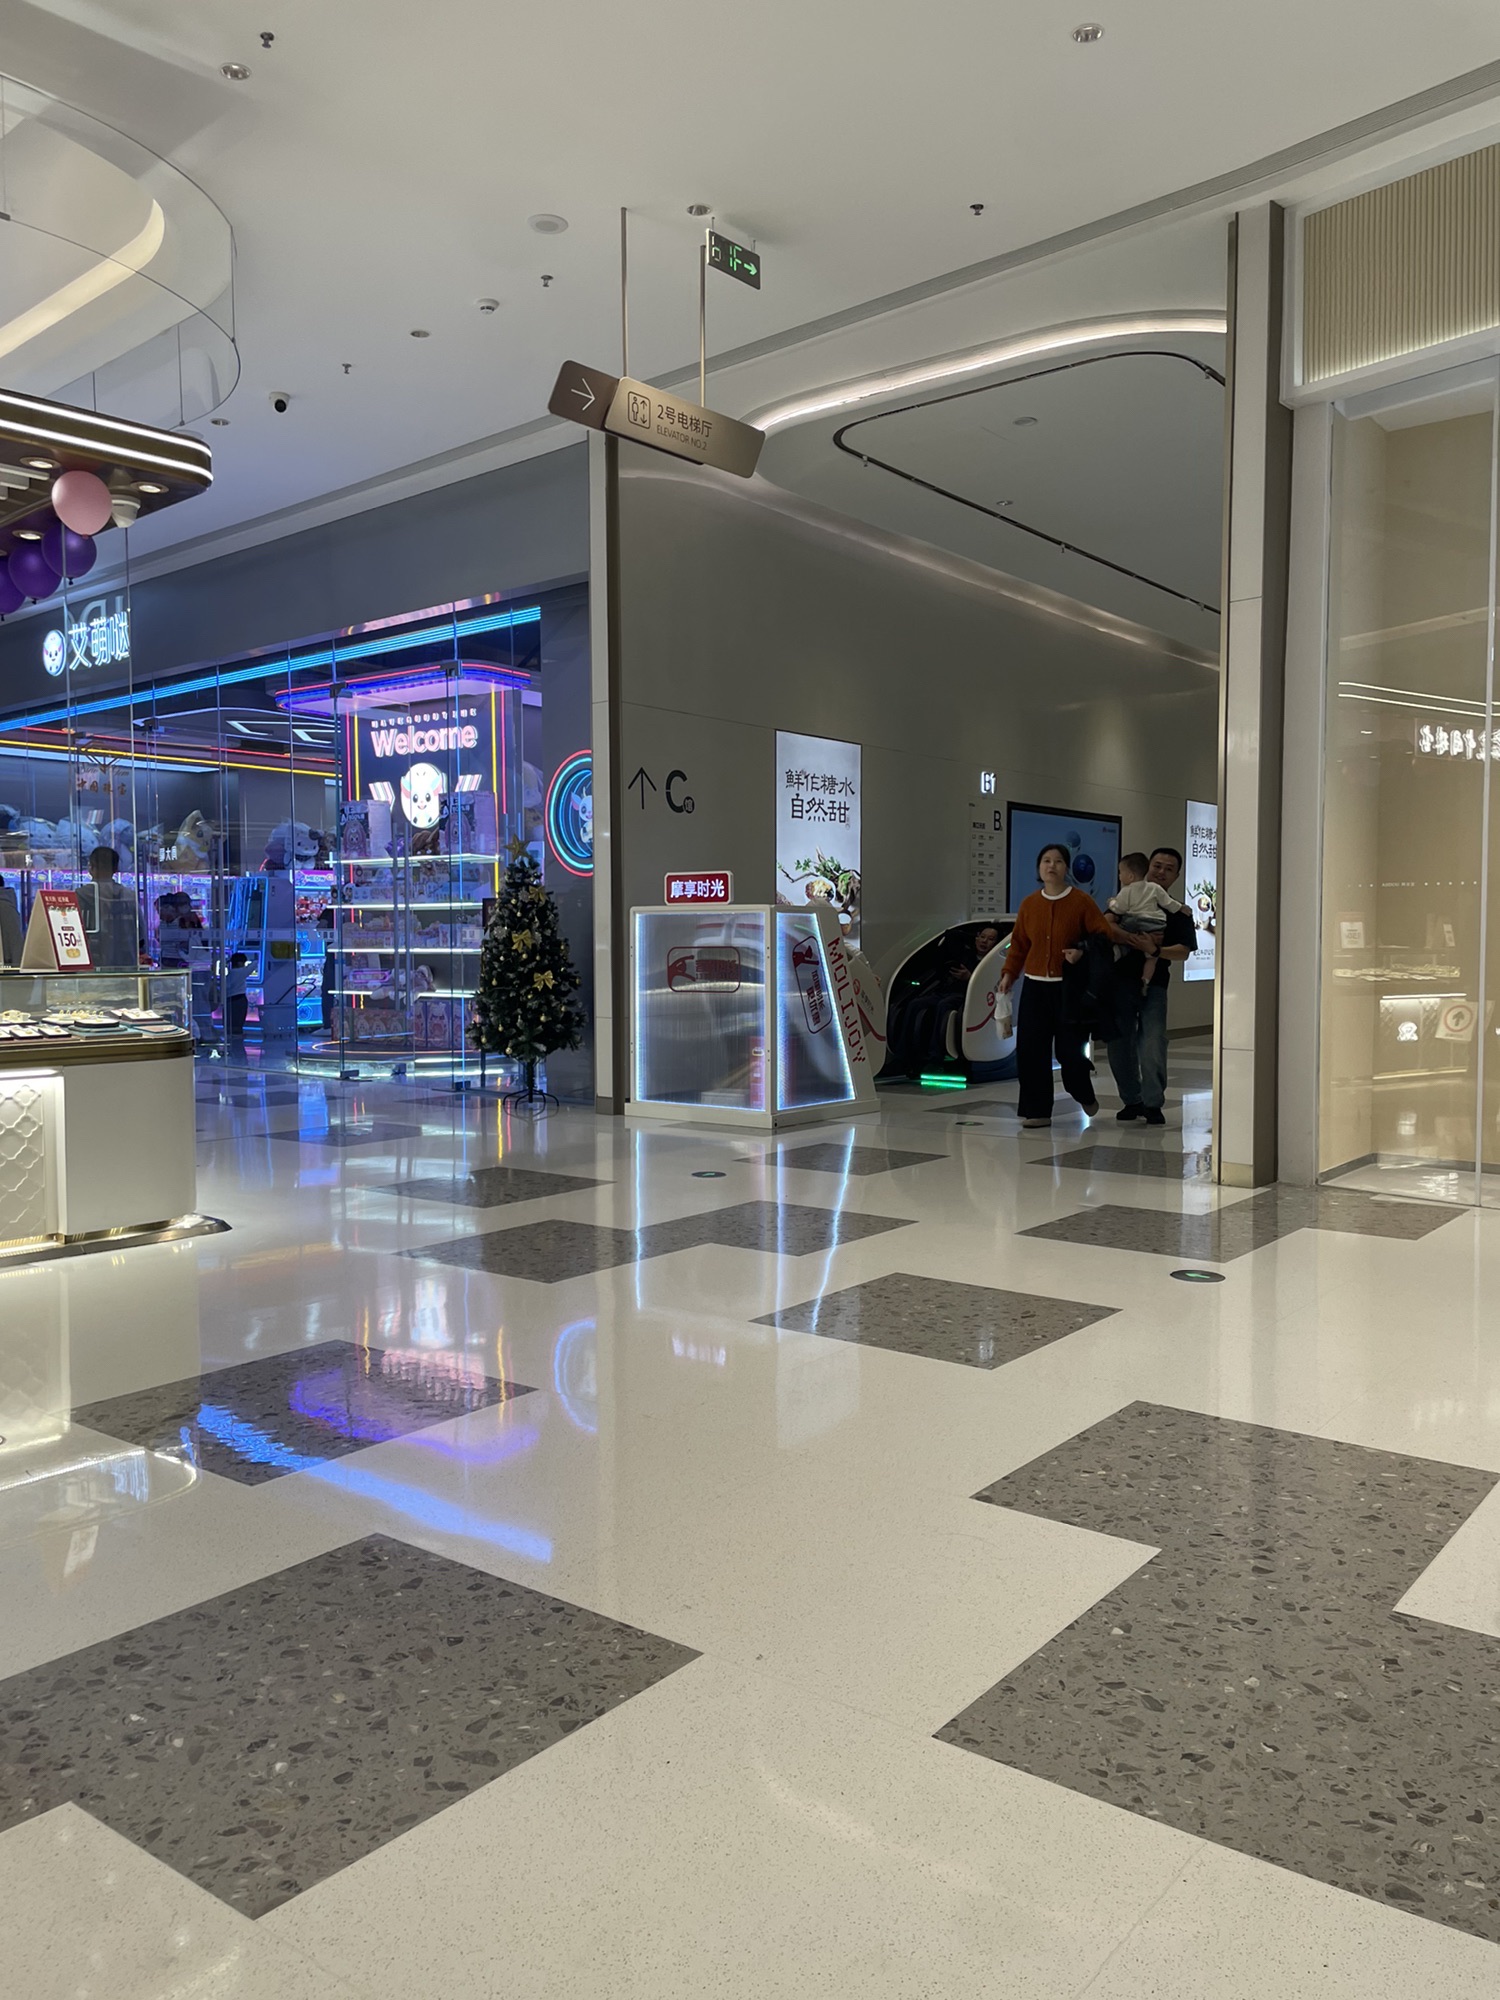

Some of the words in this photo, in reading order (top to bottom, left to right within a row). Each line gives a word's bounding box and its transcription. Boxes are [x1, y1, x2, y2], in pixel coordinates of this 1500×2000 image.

[657, 404, 713, 438] 2号电梯厅
[657, 424, 689, 445] ELEVATOR
[370, 725, 478, 758] Welcome
[791, 793, 850, 823] 自然甜
[58, 932, 78, 948] 150
[827, 937, 866, 1062] MOLIJOY
